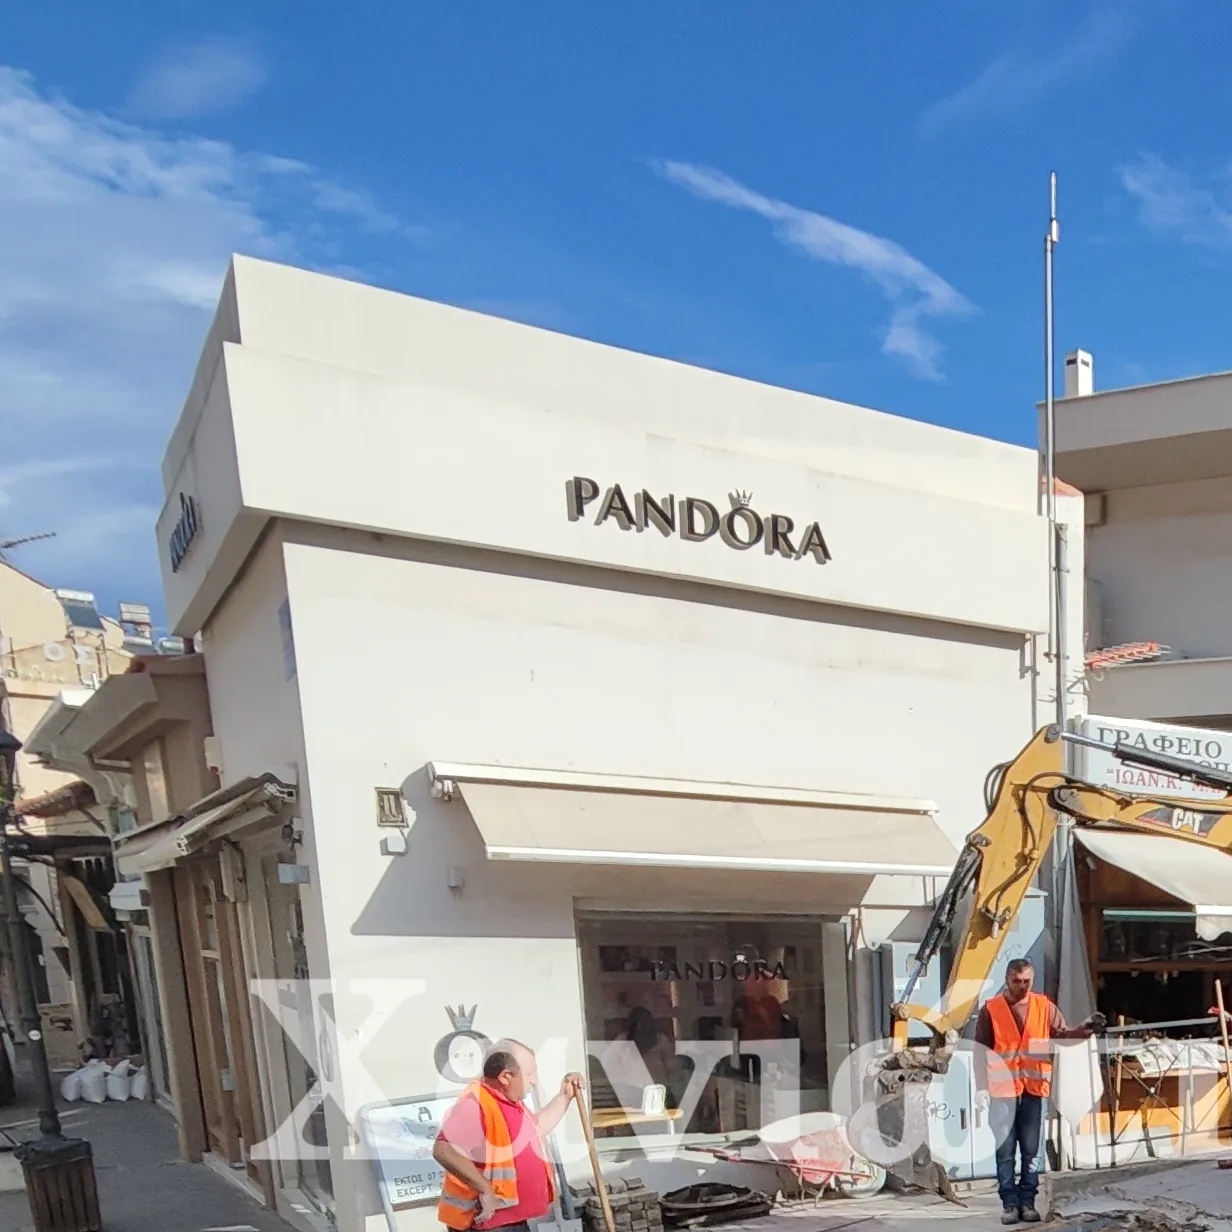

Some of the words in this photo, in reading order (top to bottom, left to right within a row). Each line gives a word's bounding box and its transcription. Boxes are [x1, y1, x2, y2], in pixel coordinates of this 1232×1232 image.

[565, 476, 832, 565] PANDORA
[1097, 727, 1222, 758] ΓΡΑΦΕΙΟ
[1171, 808, 1204, 834] CAT
[650, 958, 789, 981] PANDORA
[396, 1183, 434, 1198] EXCEPT
